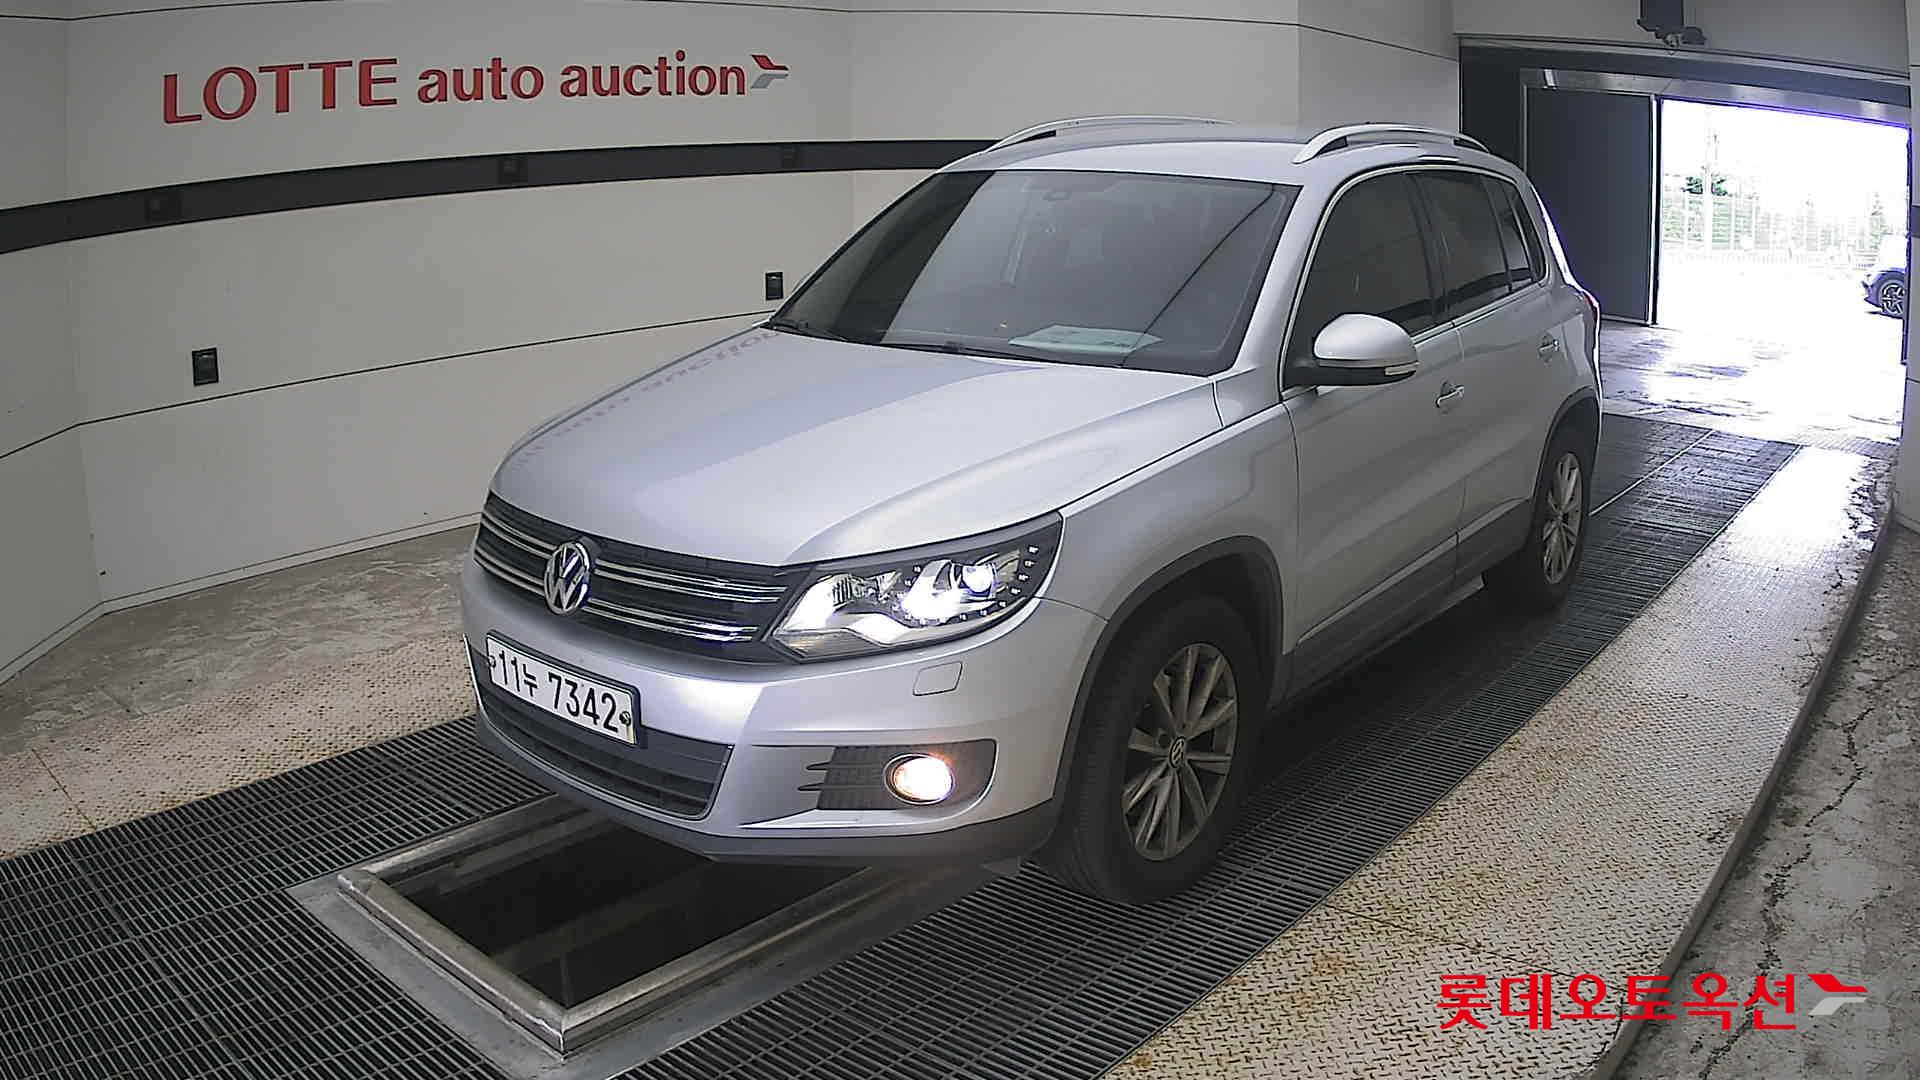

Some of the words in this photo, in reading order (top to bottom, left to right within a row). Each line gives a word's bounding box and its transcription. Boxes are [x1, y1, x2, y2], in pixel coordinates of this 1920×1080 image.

[162, 57, 398, 124] LOTTE
[416, 57, 545, 104] auto
[559, 50, 747, 97] auction
[499, 650, 539, 697] 11누
[548, 672, 619, 733] 7342
